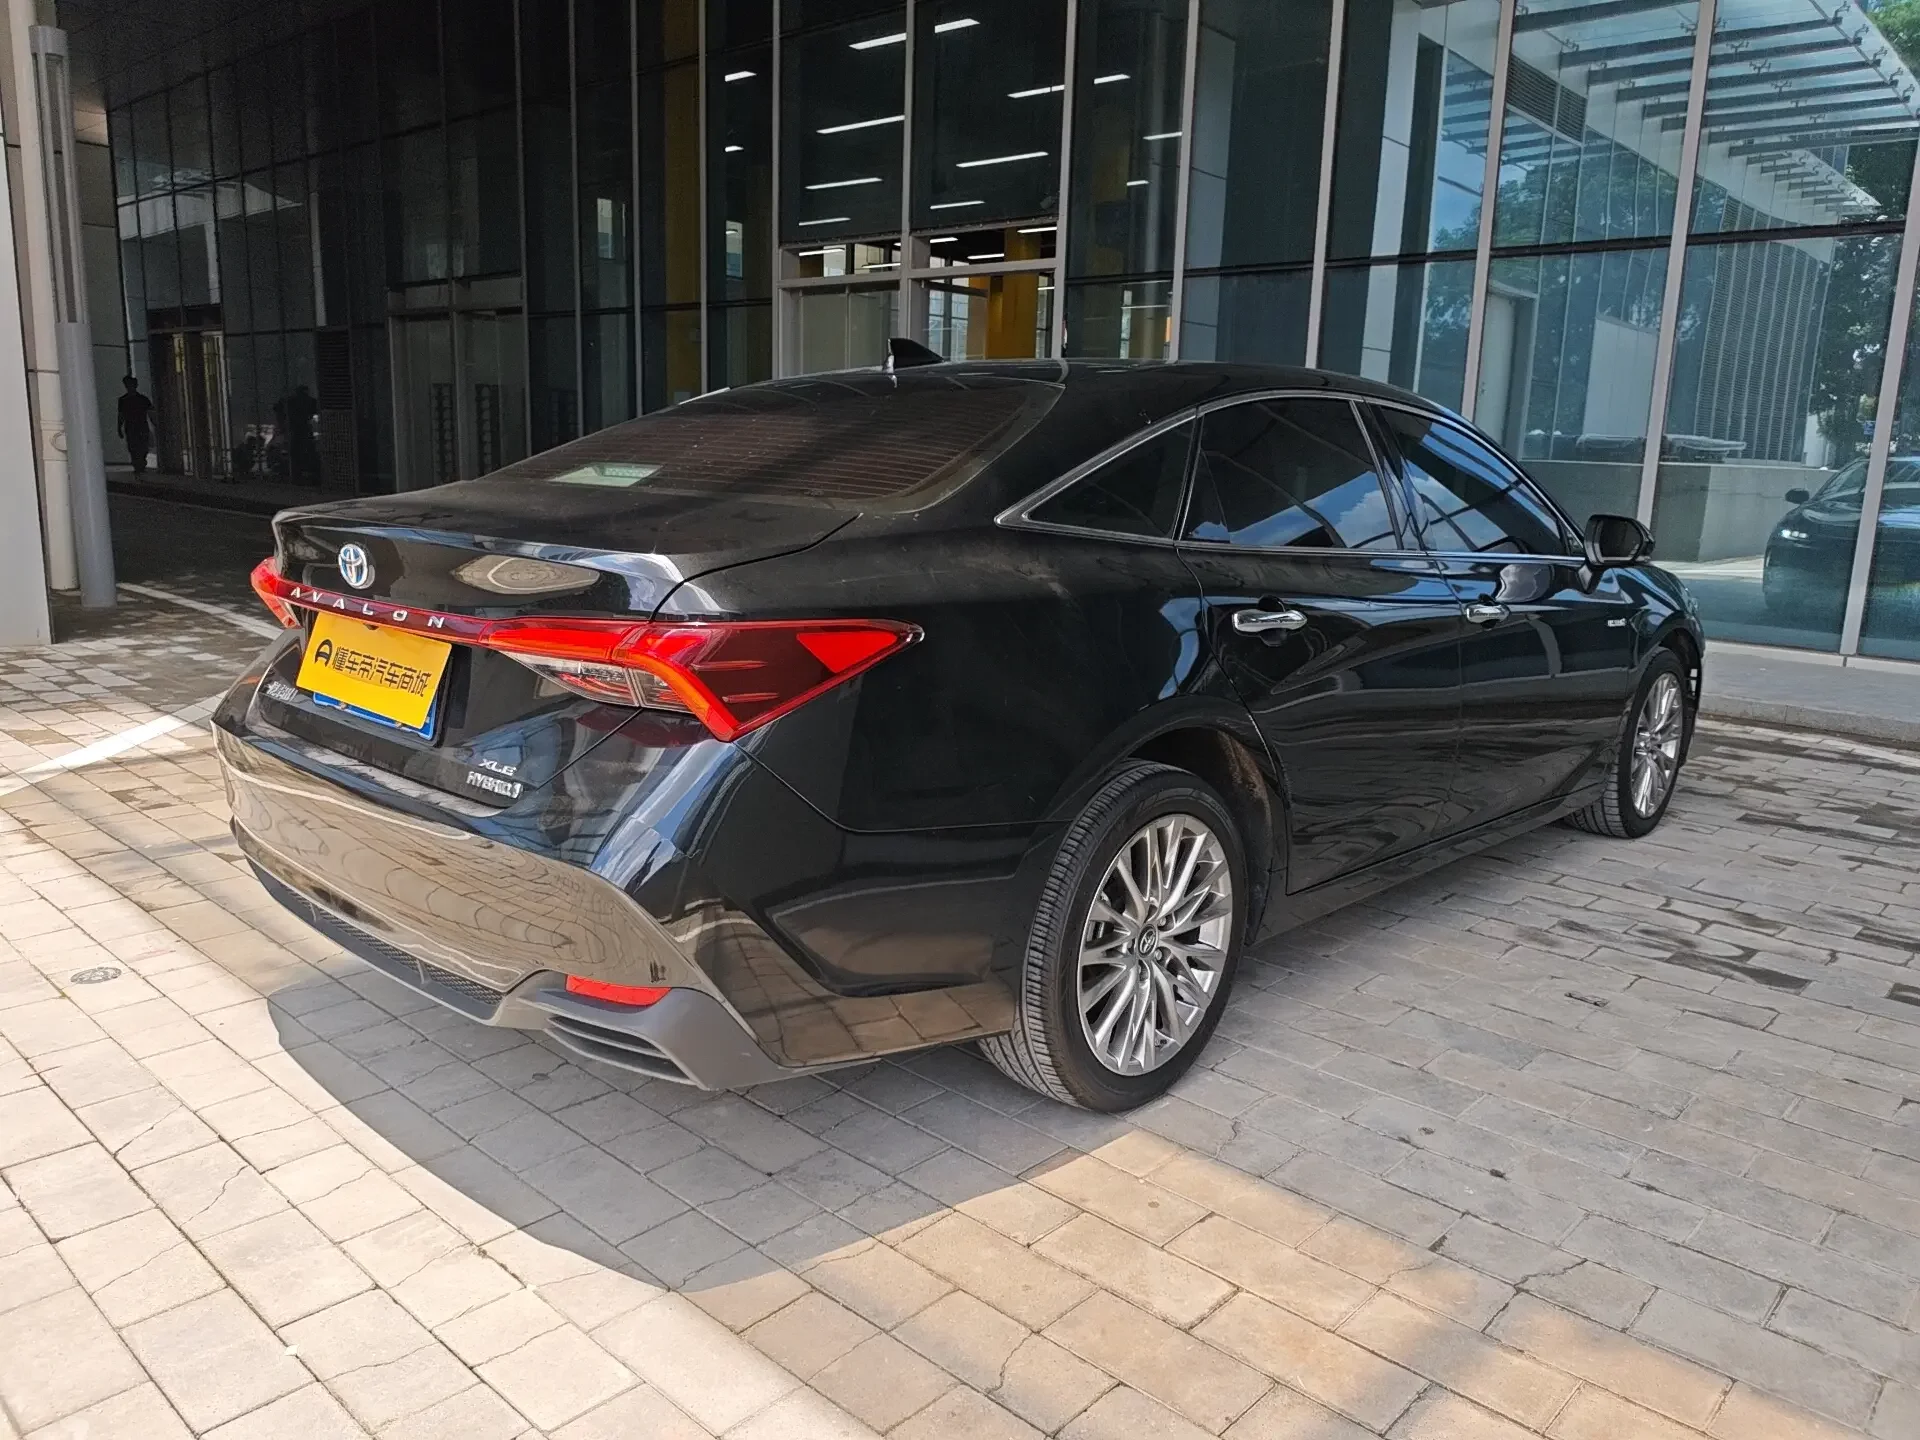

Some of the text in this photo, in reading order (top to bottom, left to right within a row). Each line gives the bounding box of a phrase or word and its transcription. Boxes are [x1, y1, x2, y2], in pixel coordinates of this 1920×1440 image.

[290, 586, 445, 629] AVALON
[332, 646, 432, 697] 懂车帝汽车商城
[478, 758, 517, 777] XLE
